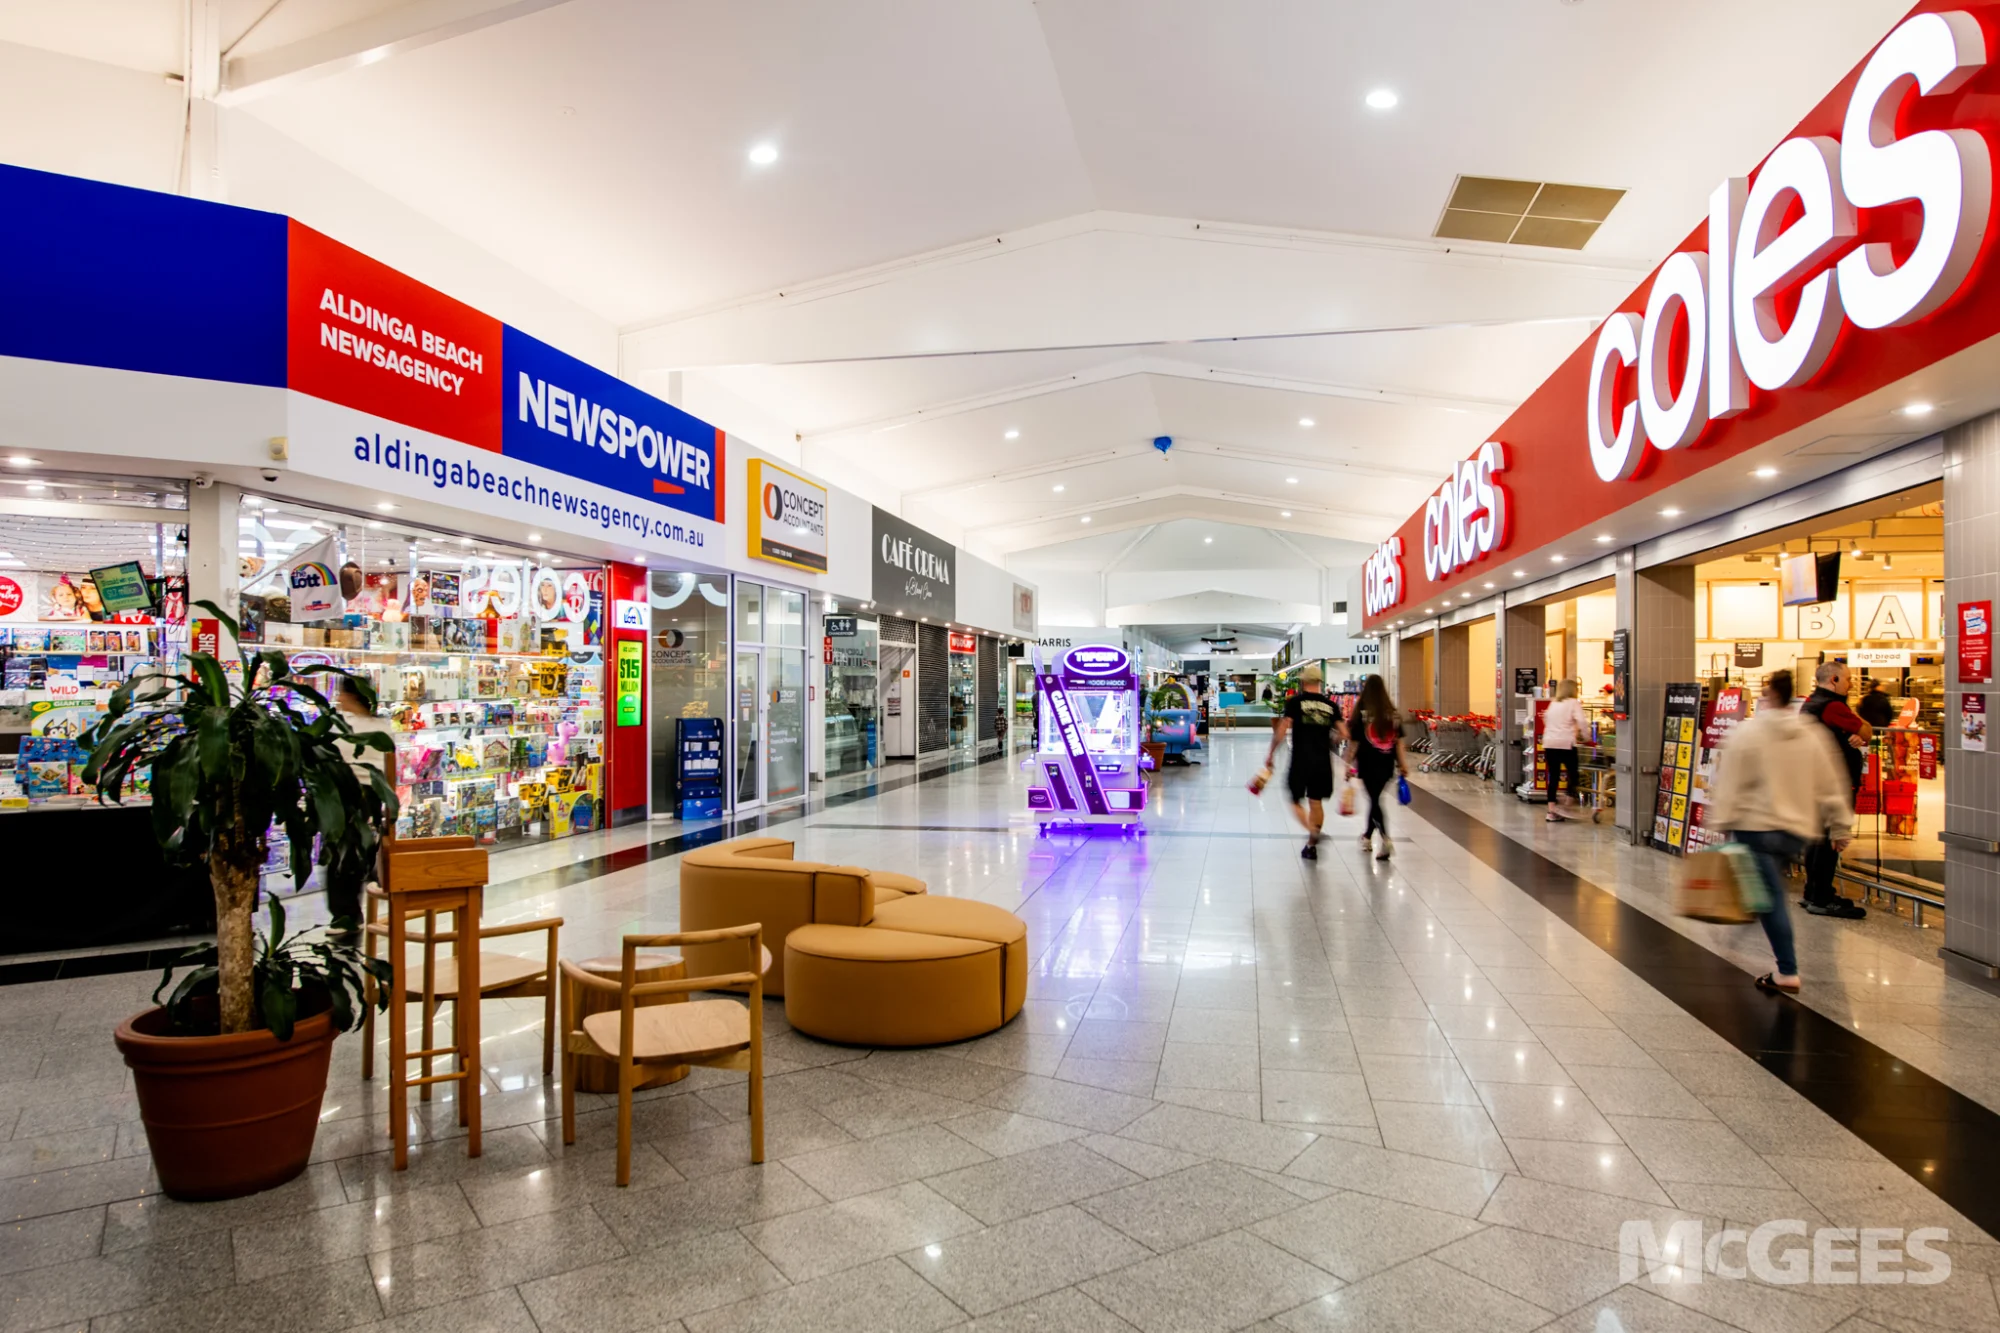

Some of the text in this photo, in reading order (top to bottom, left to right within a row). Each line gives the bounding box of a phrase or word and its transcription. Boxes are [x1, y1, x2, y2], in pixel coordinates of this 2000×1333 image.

[1587, 10, 1991, 483] coles
[319, 288, 483, 374] ALDINGA BEACH
[320, 322, 464, 396] NEWSAGENCY
[518, 371, 711, 490] NEWSPOWER
[353, 433, 705, 548] aldingabeachnewsagency.com.au
[783, 489, 824, 521] CONCEPT
[1424, 442, 1504, 582] coles
[783, 513, 824, 537] ACCOUNTANTS
[881, 533, 950, 585] CAFÉ CREMA
[1366, 537, 1400, 617] coles
[620, 657, 640, 679] $15
[651, 650, 692, 659] CONCEPT
[1857, 653, 1901, 661] Flat bread
[50, 685, 79, 695] WILD
[620, 680, 639, 692] MILLION
[1716, 692, 1739, 712] Free
[1050, 690, 1085, 757] GAME TIME
